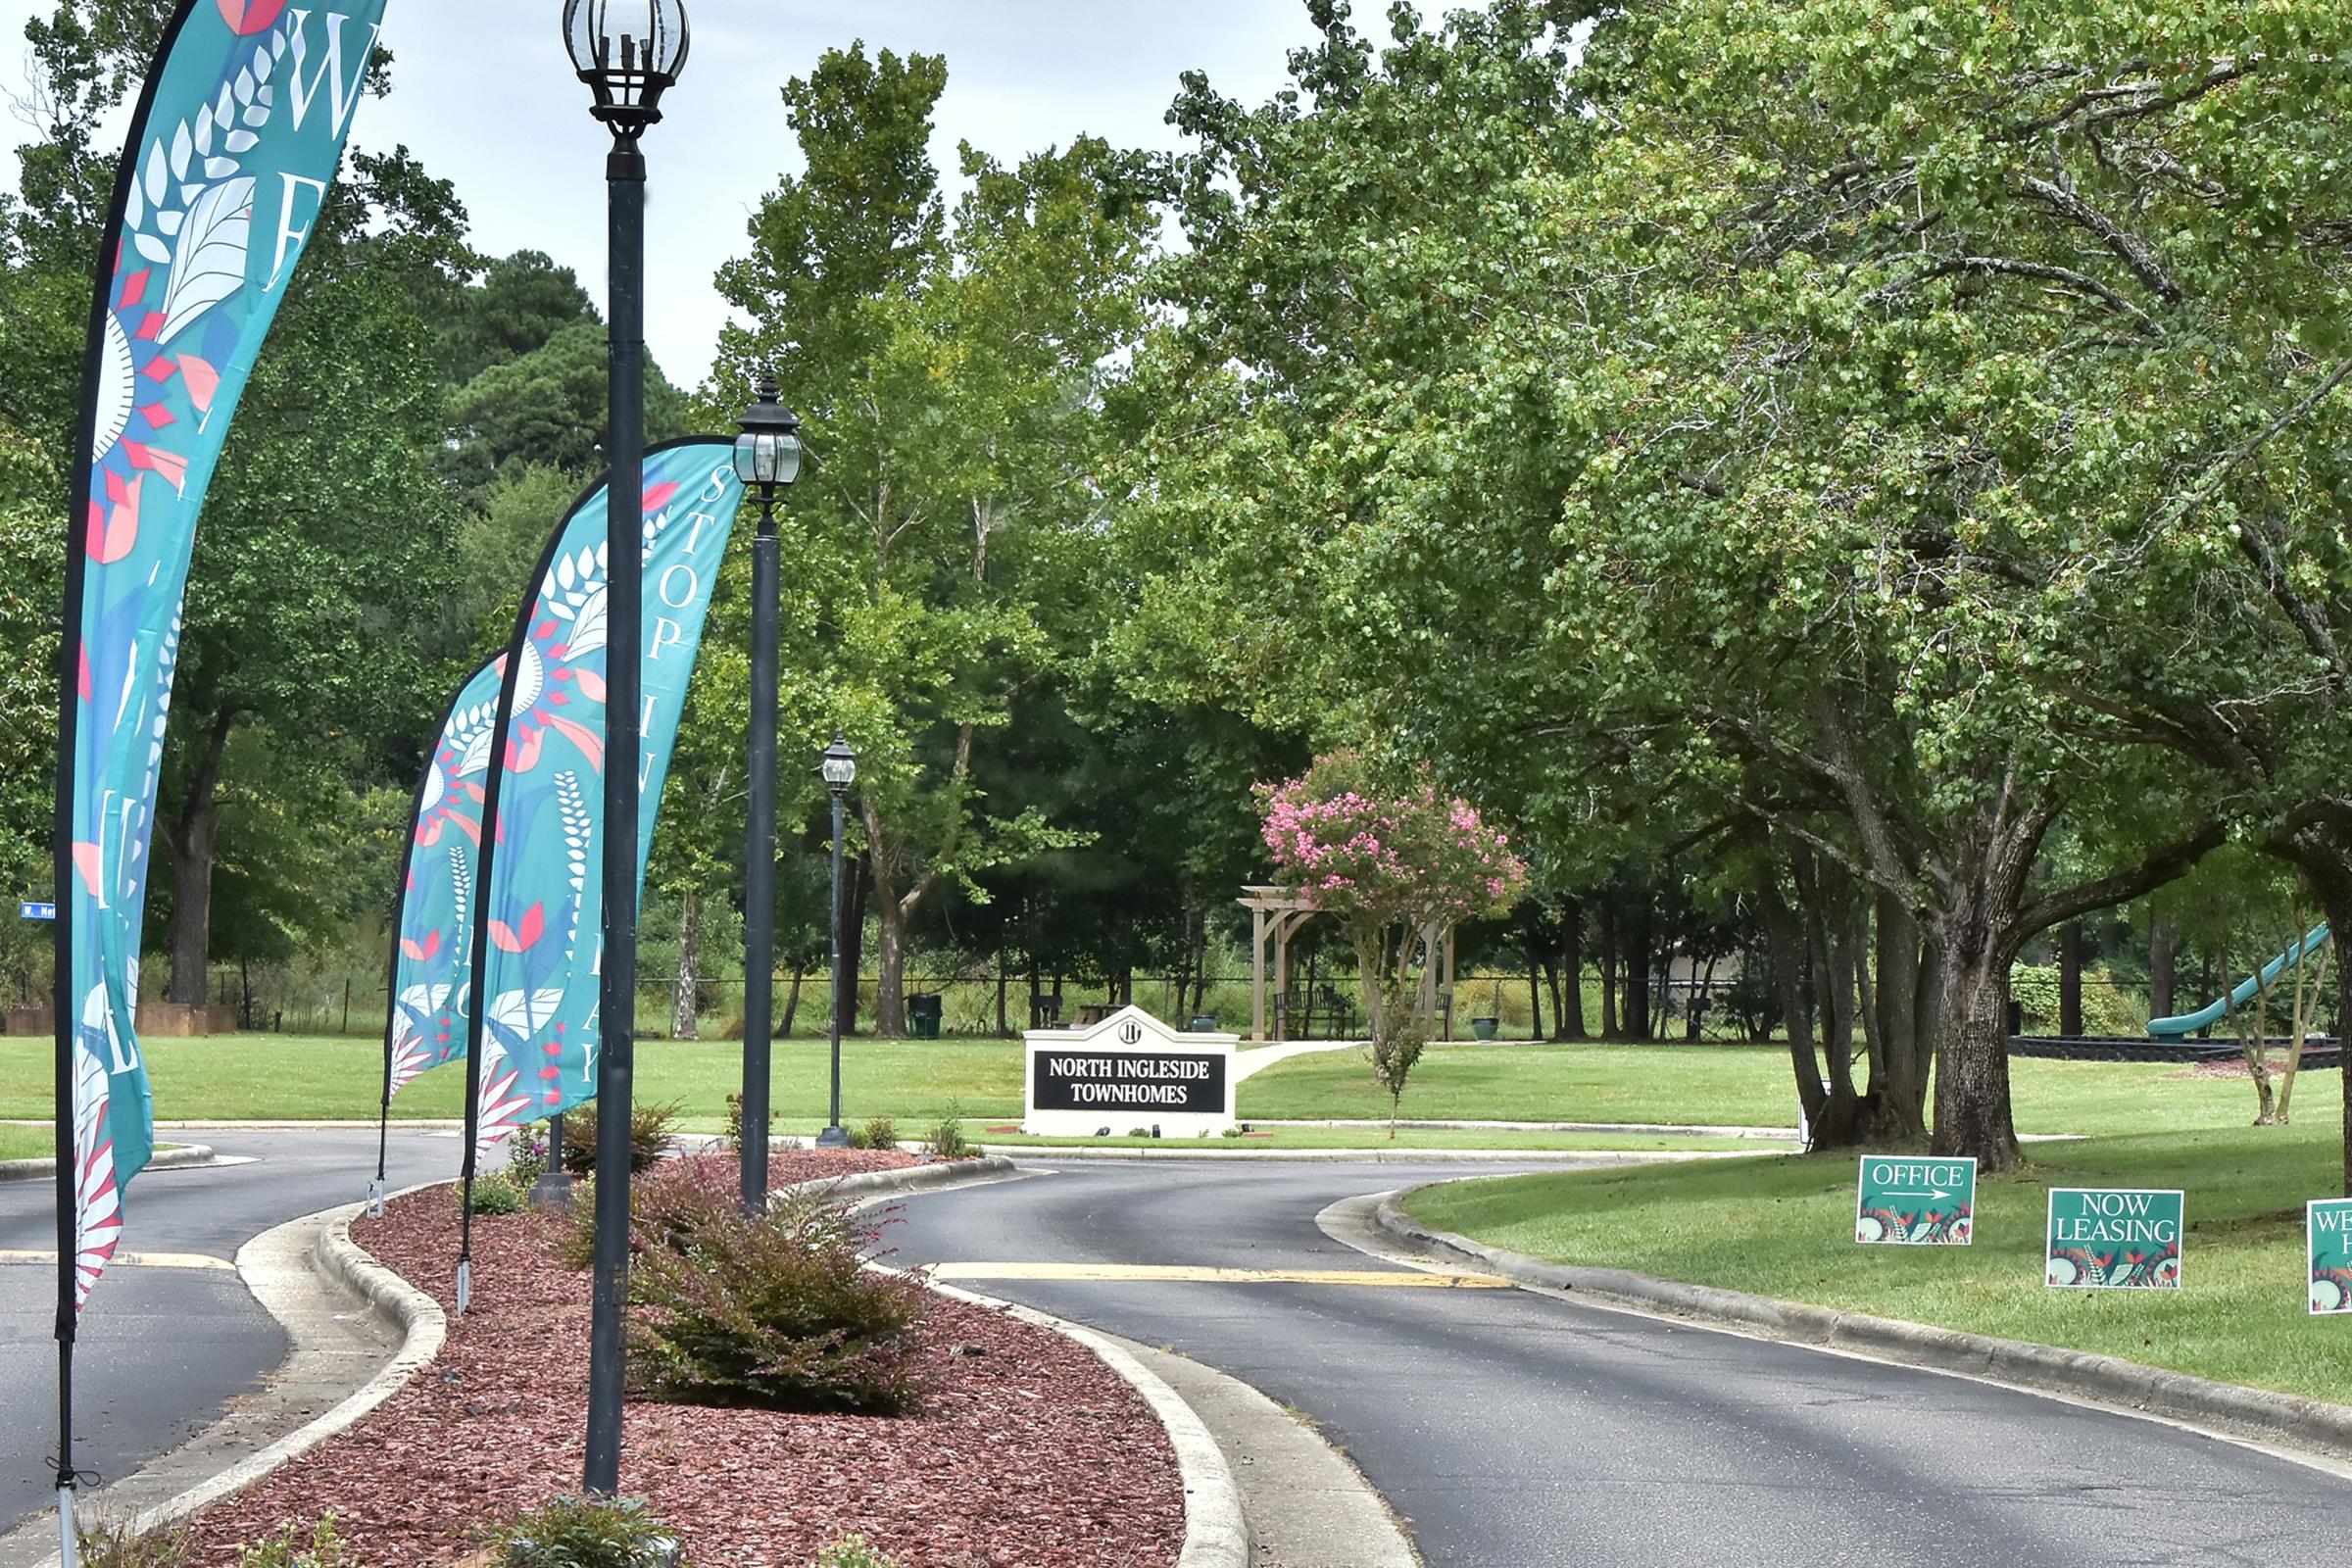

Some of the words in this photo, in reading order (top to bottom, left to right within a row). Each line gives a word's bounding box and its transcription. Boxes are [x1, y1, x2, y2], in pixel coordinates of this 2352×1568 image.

[647, 465, 734, 661] STOP
[1050, 1057, 1112, 1077] NORTH
[1117, 1059, 1209, 1080] INGLESIDE
[1070, 1083, 1188, 1104] TOWNHOMES
[1872, 1163, 1964, 1187] OFFICE
[2081, 1193, 2154, 1216] NOW
[2056, 1217, 2175, 1243] LEASING
